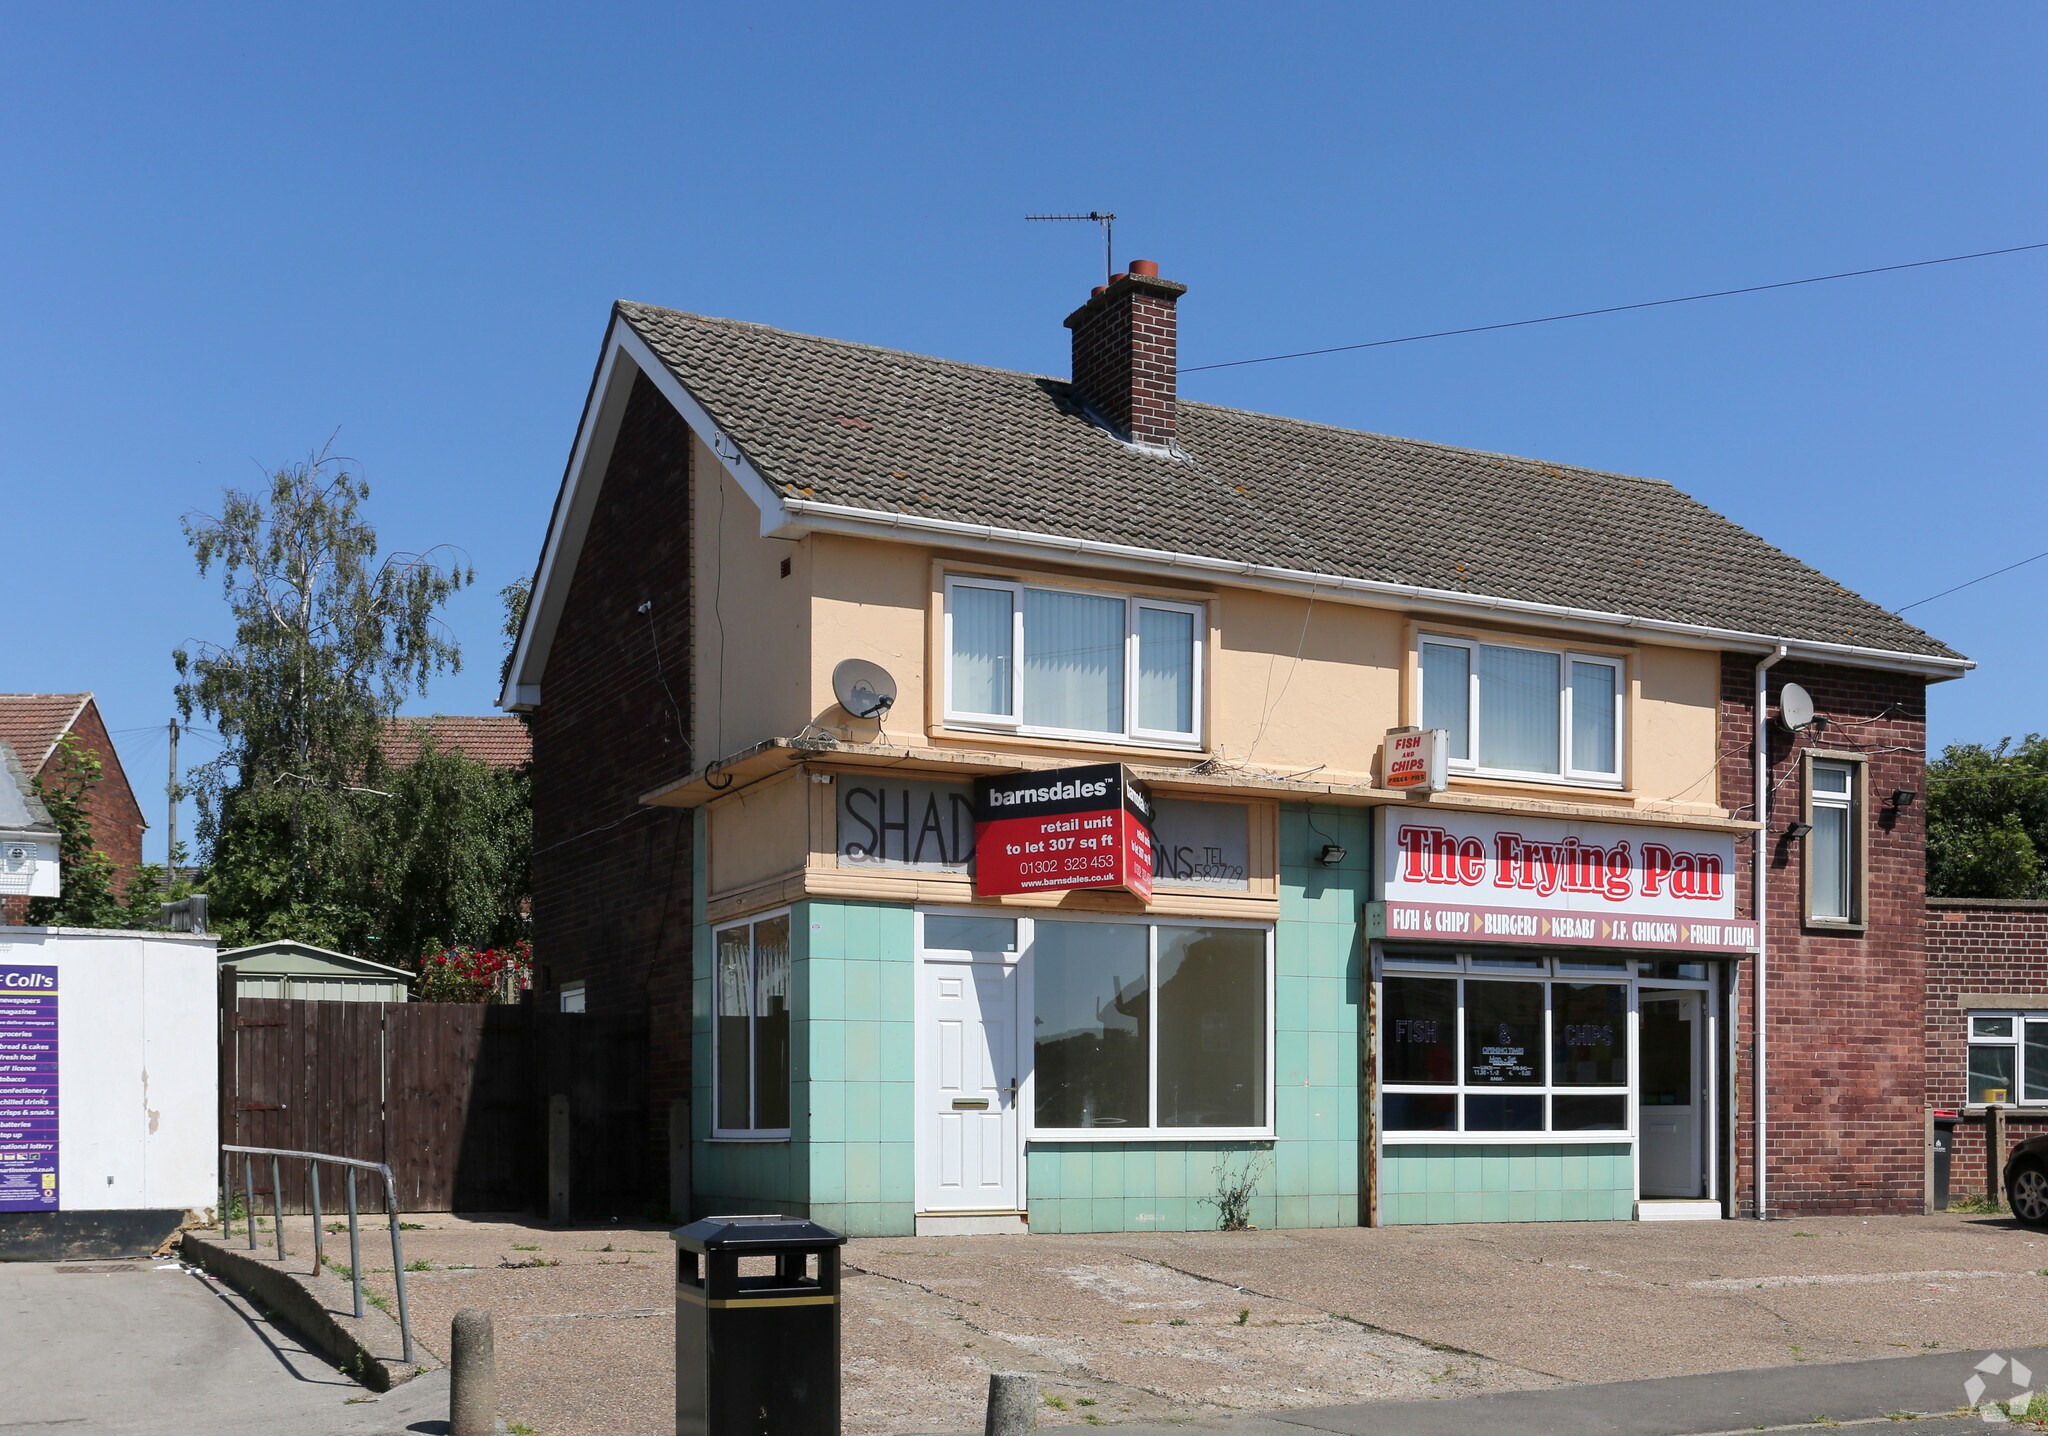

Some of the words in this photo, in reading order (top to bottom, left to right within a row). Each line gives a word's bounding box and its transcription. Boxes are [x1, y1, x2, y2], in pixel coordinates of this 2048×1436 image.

[1395, 736, 1421, 750] FISH
[1391, 758, 1424, 773] CHIPS
[1040, 818, 1079, 834] retail
[1083, 815, 1113, 829] unit
[1006, 843, 1021, 856] to
[1025, 841, 1044, 854] let
[1048, 837, 1075, 851] 307
[1079, 838, 1097, 850] sq
[1101, 834, 1113, 846] ft
[1019, 859, 1058, 875] 01302
[1064, 857, 1087, 871] 323
[1090, 854, 1114, 868] 453
[1203, 846, 1226, 865] TEL
[1398, 824, 1486, 886] The
[1493, 831, 1633, 902] Frying
[1640, 842, 1724, 901] Pan
[1021, 872, 1115, 888] www.barnsdales.co.uk
[1194, 864, 1243, 885] 582729
[1393, 908, 1420, 931] FISH
[1423, 910, 1432, 931] &
[1435, 910, 1471, 933] CHIPS
[1484, 913, 1538, 937] BURGERS
[1551, 917, 1596, 939] KEBABS
[1611, 920, 1629, 941] S.F.
[1632, 921, 1678, 943] CHICKEN
[1690, 924, 1721, 945] FRUIT
[1722, 926, 1755, 947] SLUSH
[1396, 1019, 1437, 1043] FISH
[1499, 1023, 1511, 1045] &
[1564, 1024, 1613, 1046] CHIPS
[19, 1053, 37, 1061] food
